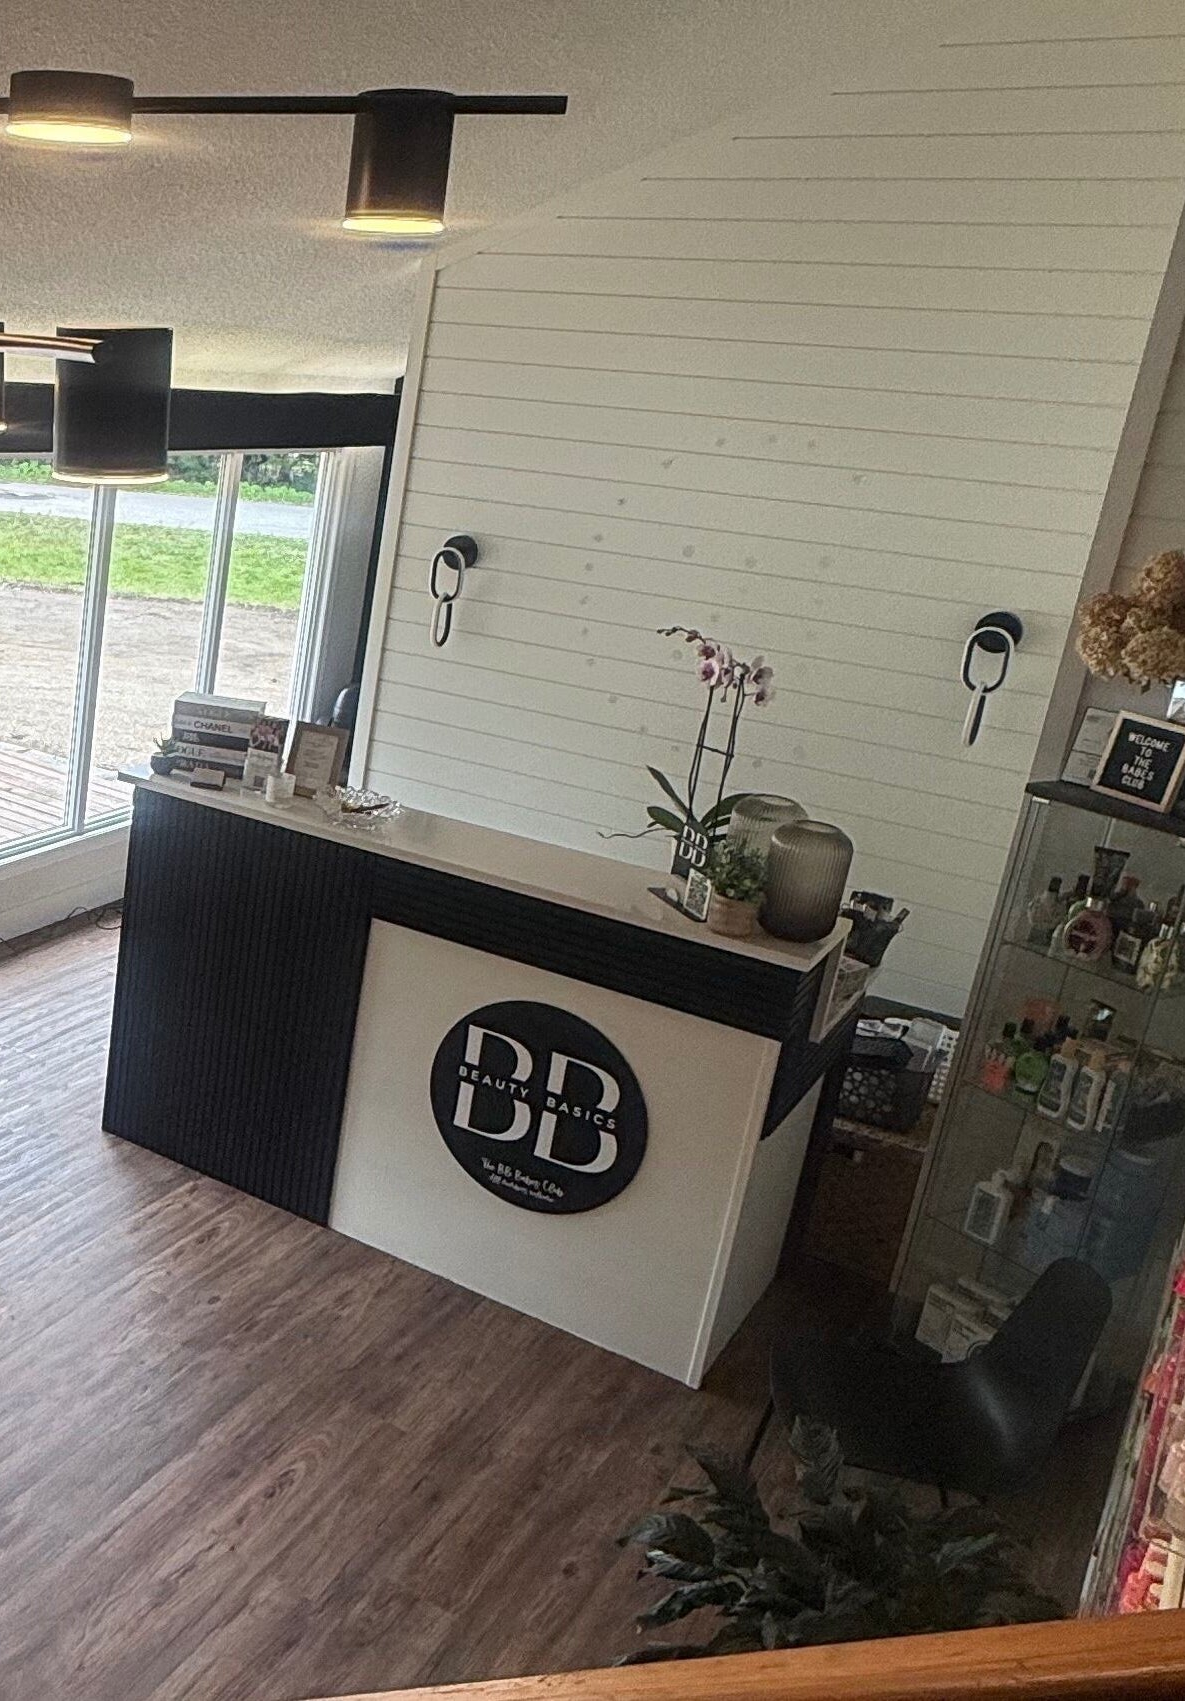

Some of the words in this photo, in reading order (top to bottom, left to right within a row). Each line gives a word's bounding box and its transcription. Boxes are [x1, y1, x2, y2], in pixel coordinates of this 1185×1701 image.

[194, 720, 232, 733] CHANEL
[1128, 732, 1171, 752] WELCOME
[1140, 746, 1153, 758] TO
[1134, 755, 1153, 770] THE
[1121, 762, 1155, 781] BABES
[1121, 774, 1145, 790] CLUB
[458, 1065, 529, 1098] BEAUTY
[546, 1096, 616, 1130] BASICS
